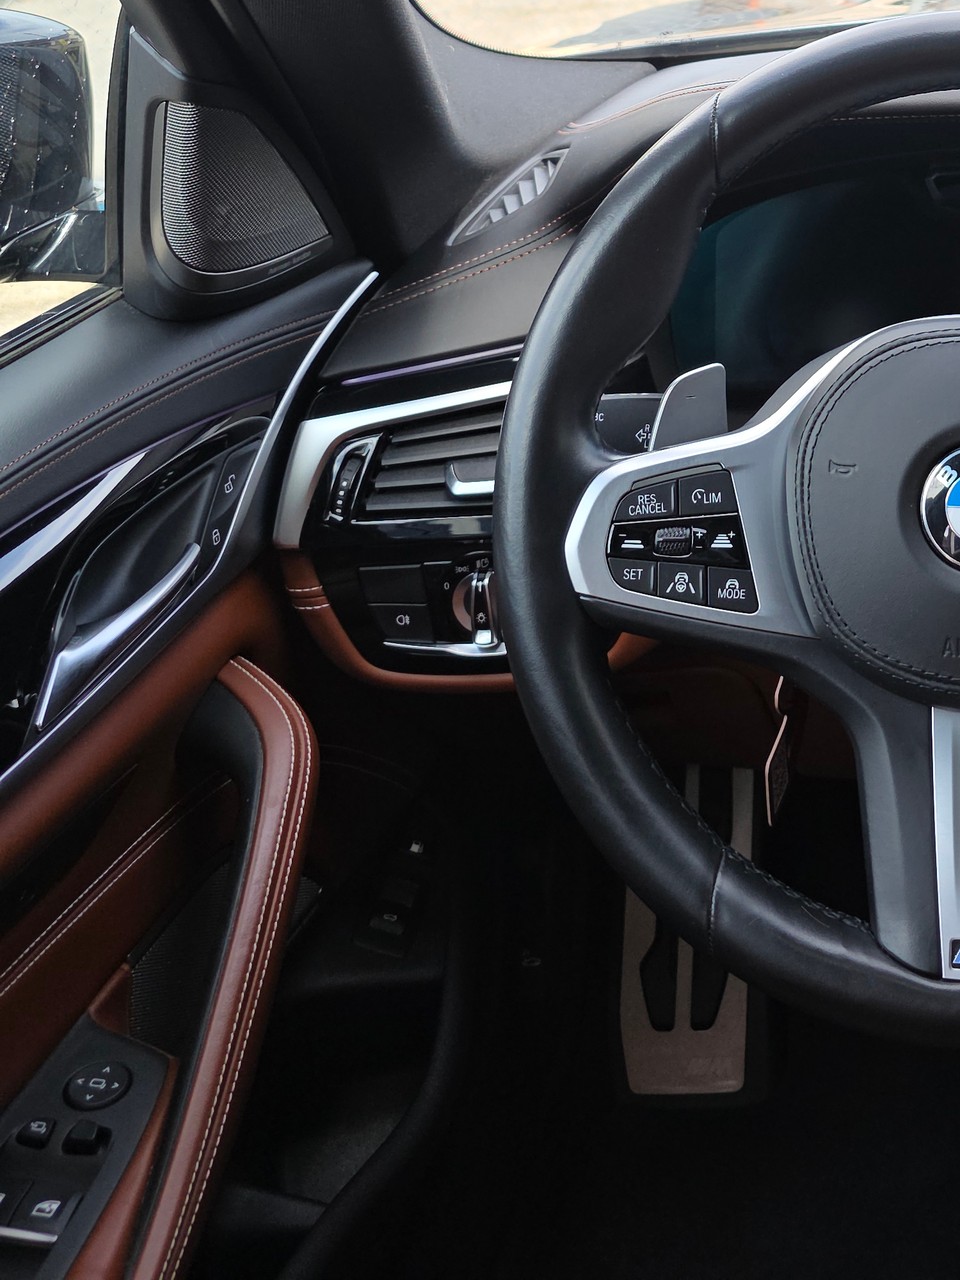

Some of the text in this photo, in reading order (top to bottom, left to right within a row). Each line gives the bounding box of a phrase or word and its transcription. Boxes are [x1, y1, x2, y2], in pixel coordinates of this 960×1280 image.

[637, 493, 657, 505] RES
[703, 492, 722, 504] LIM
[628, 503, 667, 516] CANCEL
[623, 568, 643, 580] SET
[717, 588, 746, 599] MODE
